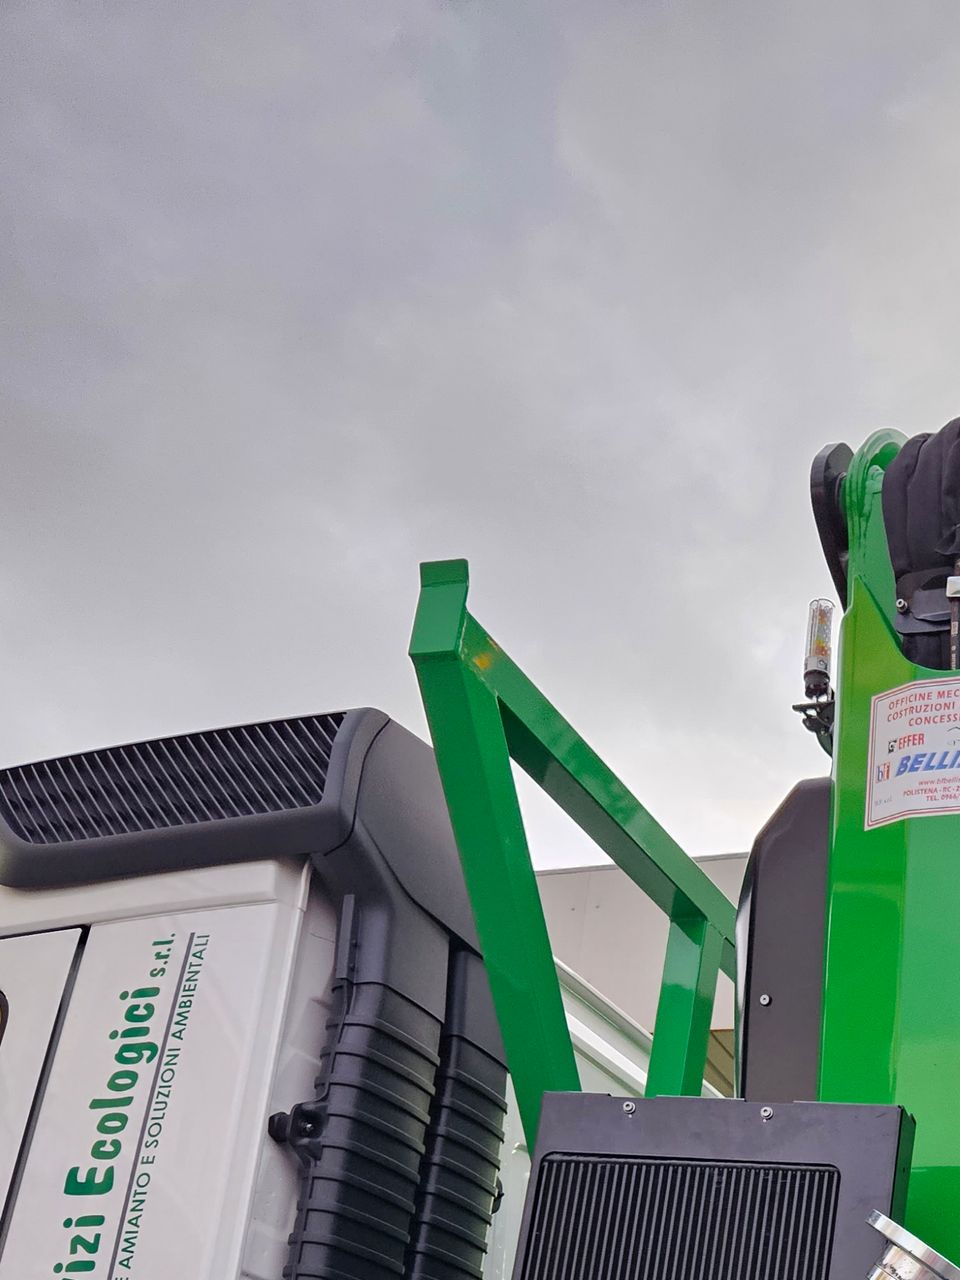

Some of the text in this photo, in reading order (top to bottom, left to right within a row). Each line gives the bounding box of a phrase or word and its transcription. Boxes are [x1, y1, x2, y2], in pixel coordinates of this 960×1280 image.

[888, 691, 932, 711] OFFICINE
[887, 702, 955, 723] COSTRUZIONI
[898, 732, 925, 750] EFFER
[903, 787, 938, 797] POLISTENA
[171, 934, 210, 1040] AMBIENTALI
[64, 986, 160, 1196] Ecologici
[150, 932, 176, 977] s.r.l.
[145, 1047, 181, 1149] SOLUZIONI
[141, 1155, 156, 1165] E
[118, 1171, 151, 1269] AMIANTO
